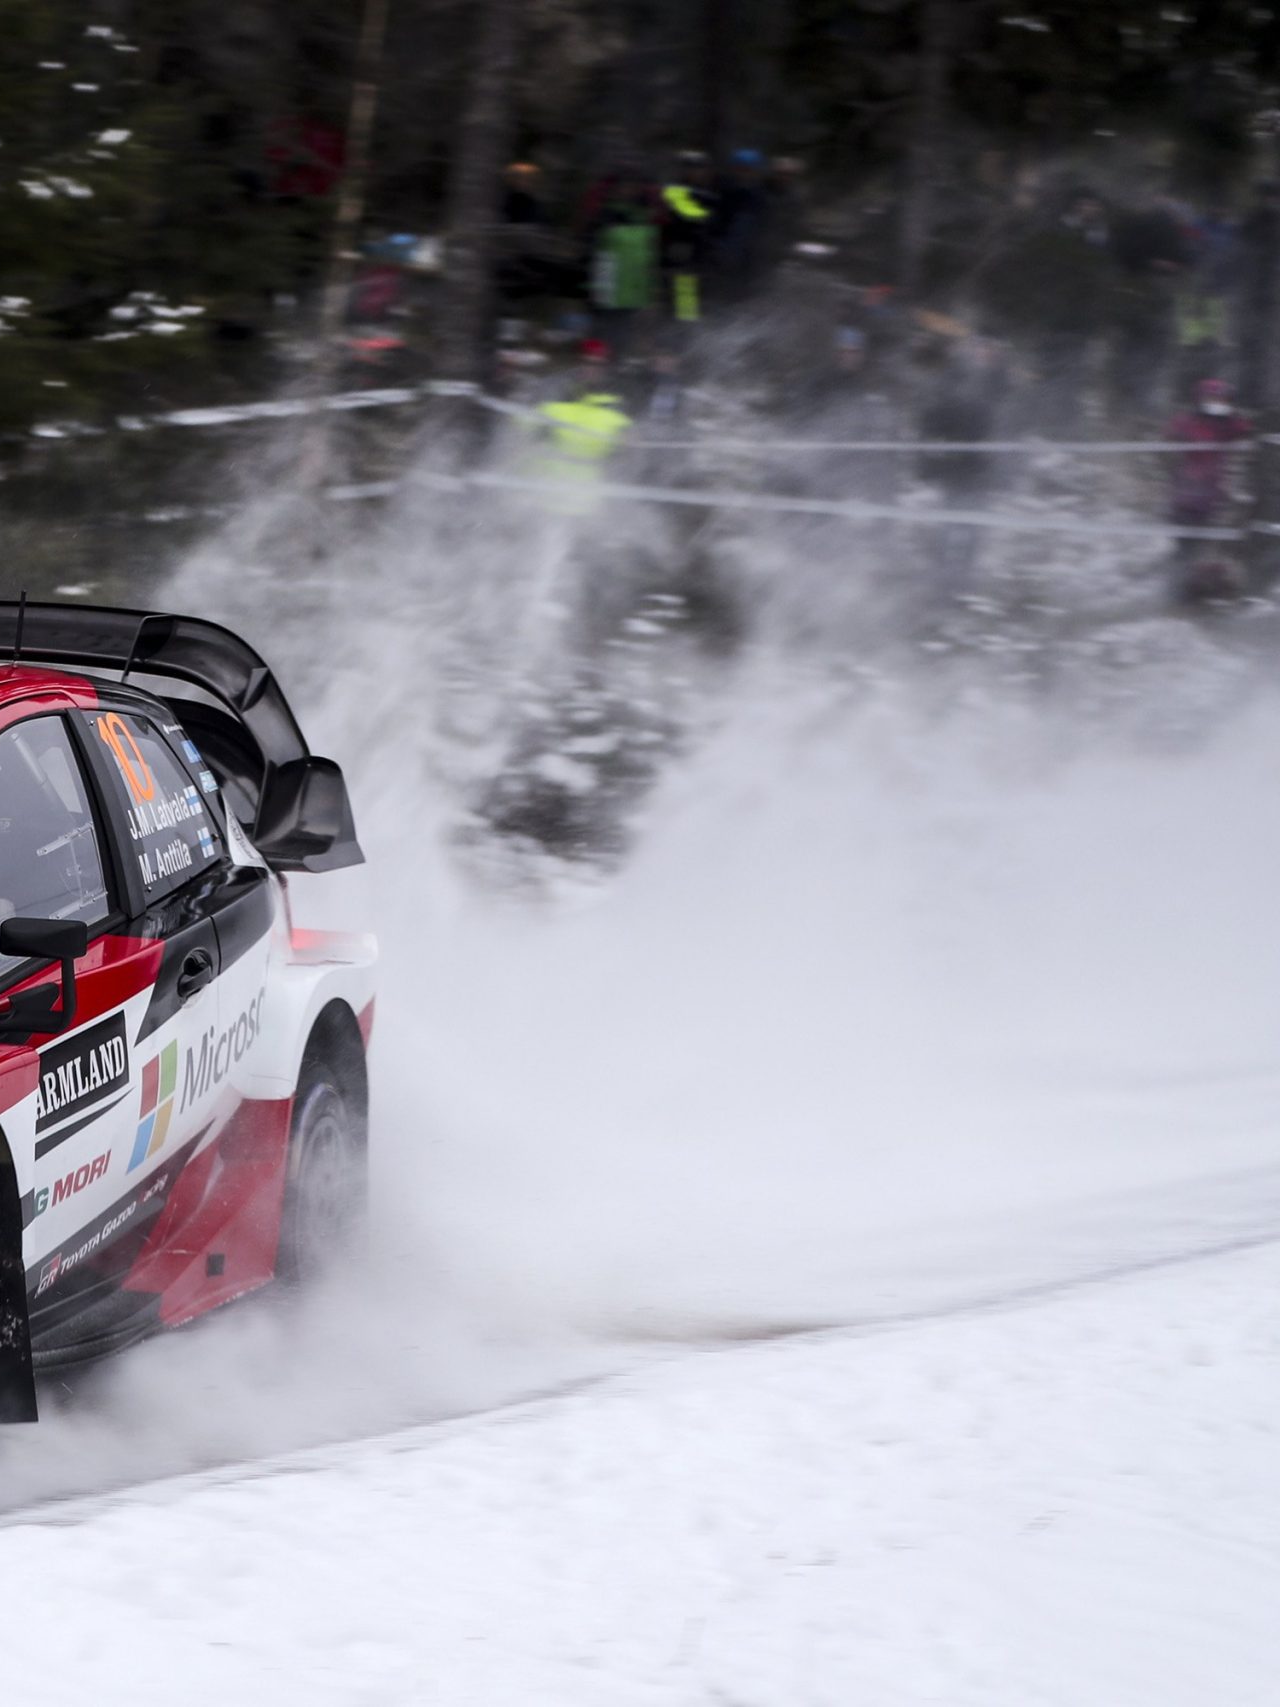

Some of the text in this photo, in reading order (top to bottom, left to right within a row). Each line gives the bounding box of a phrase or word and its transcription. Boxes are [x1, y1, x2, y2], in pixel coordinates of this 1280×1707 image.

[96, 711, 155, 805] 10
[128, 791, 191, 841] J.M. Latvala
[138, 838, 193, 885] M. Anttila
[51, 1149, 112, 1209] MORI
[61, 1232, 100, 1275] TOYOTA
